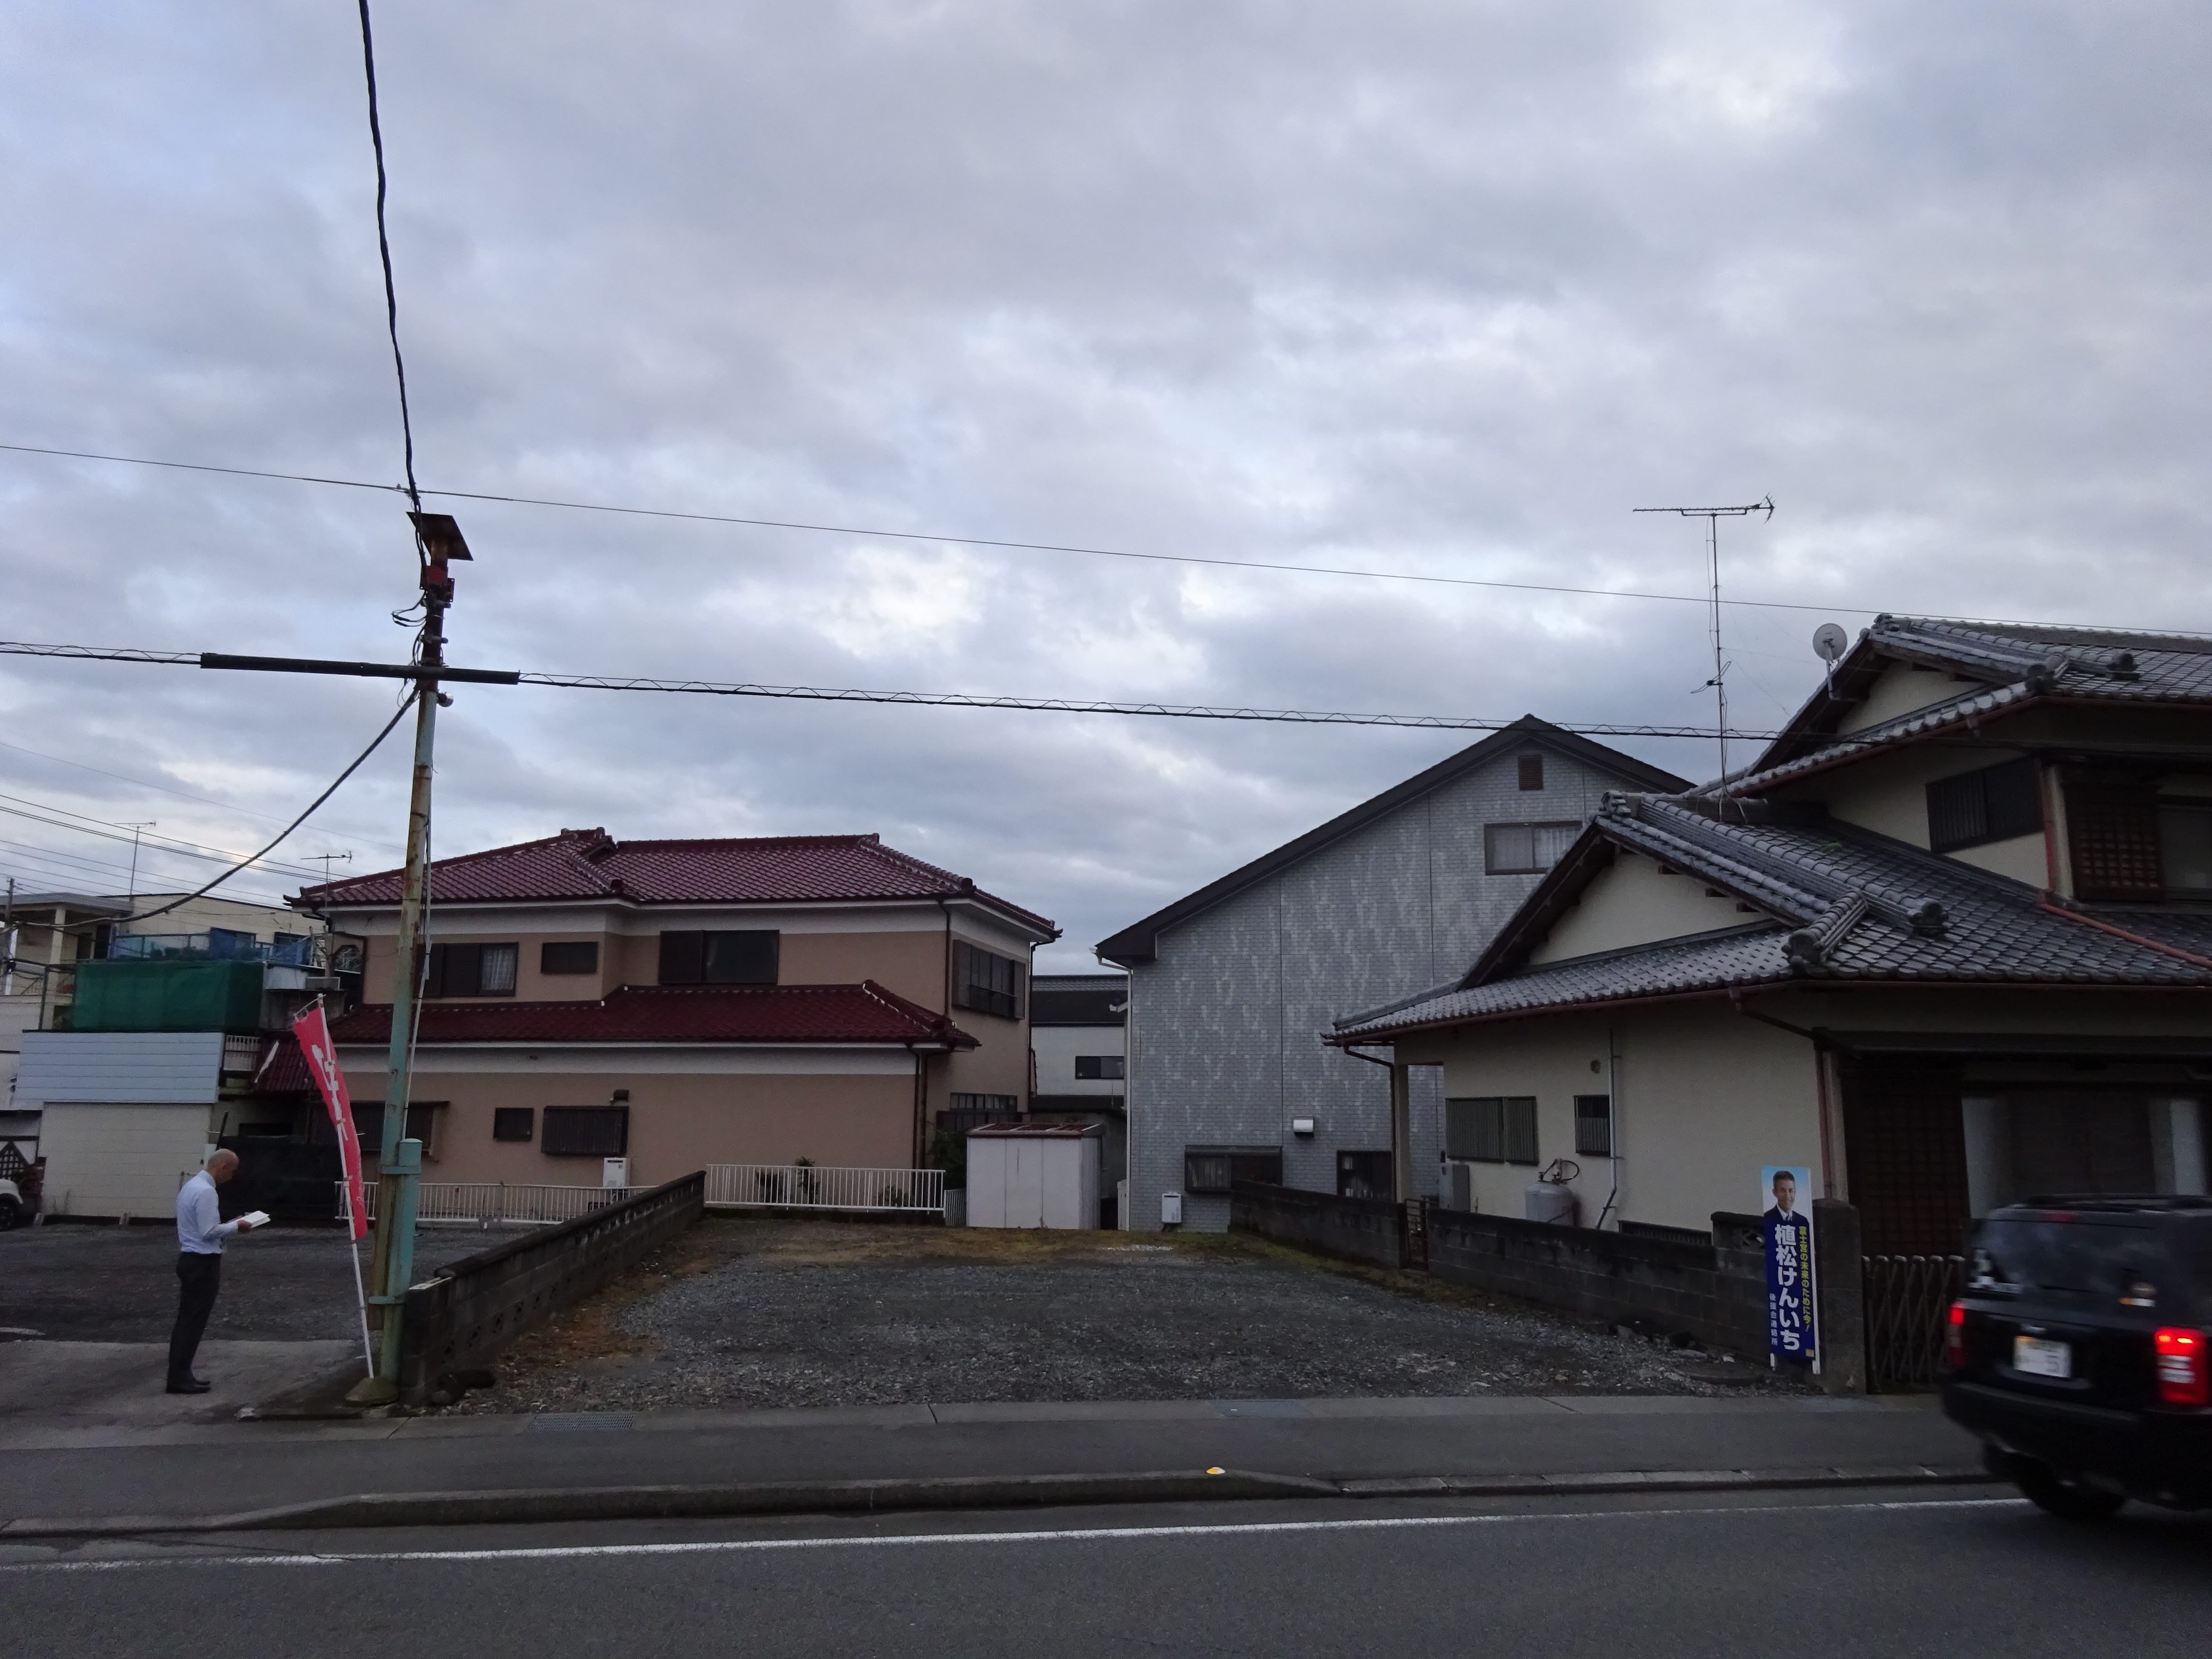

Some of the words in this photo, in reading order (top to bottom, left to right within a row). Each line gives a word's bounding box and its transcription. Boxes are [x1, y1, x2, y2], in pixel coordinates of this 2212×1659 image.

[1775, 1224, 1800, 1350] 植松けんいち
